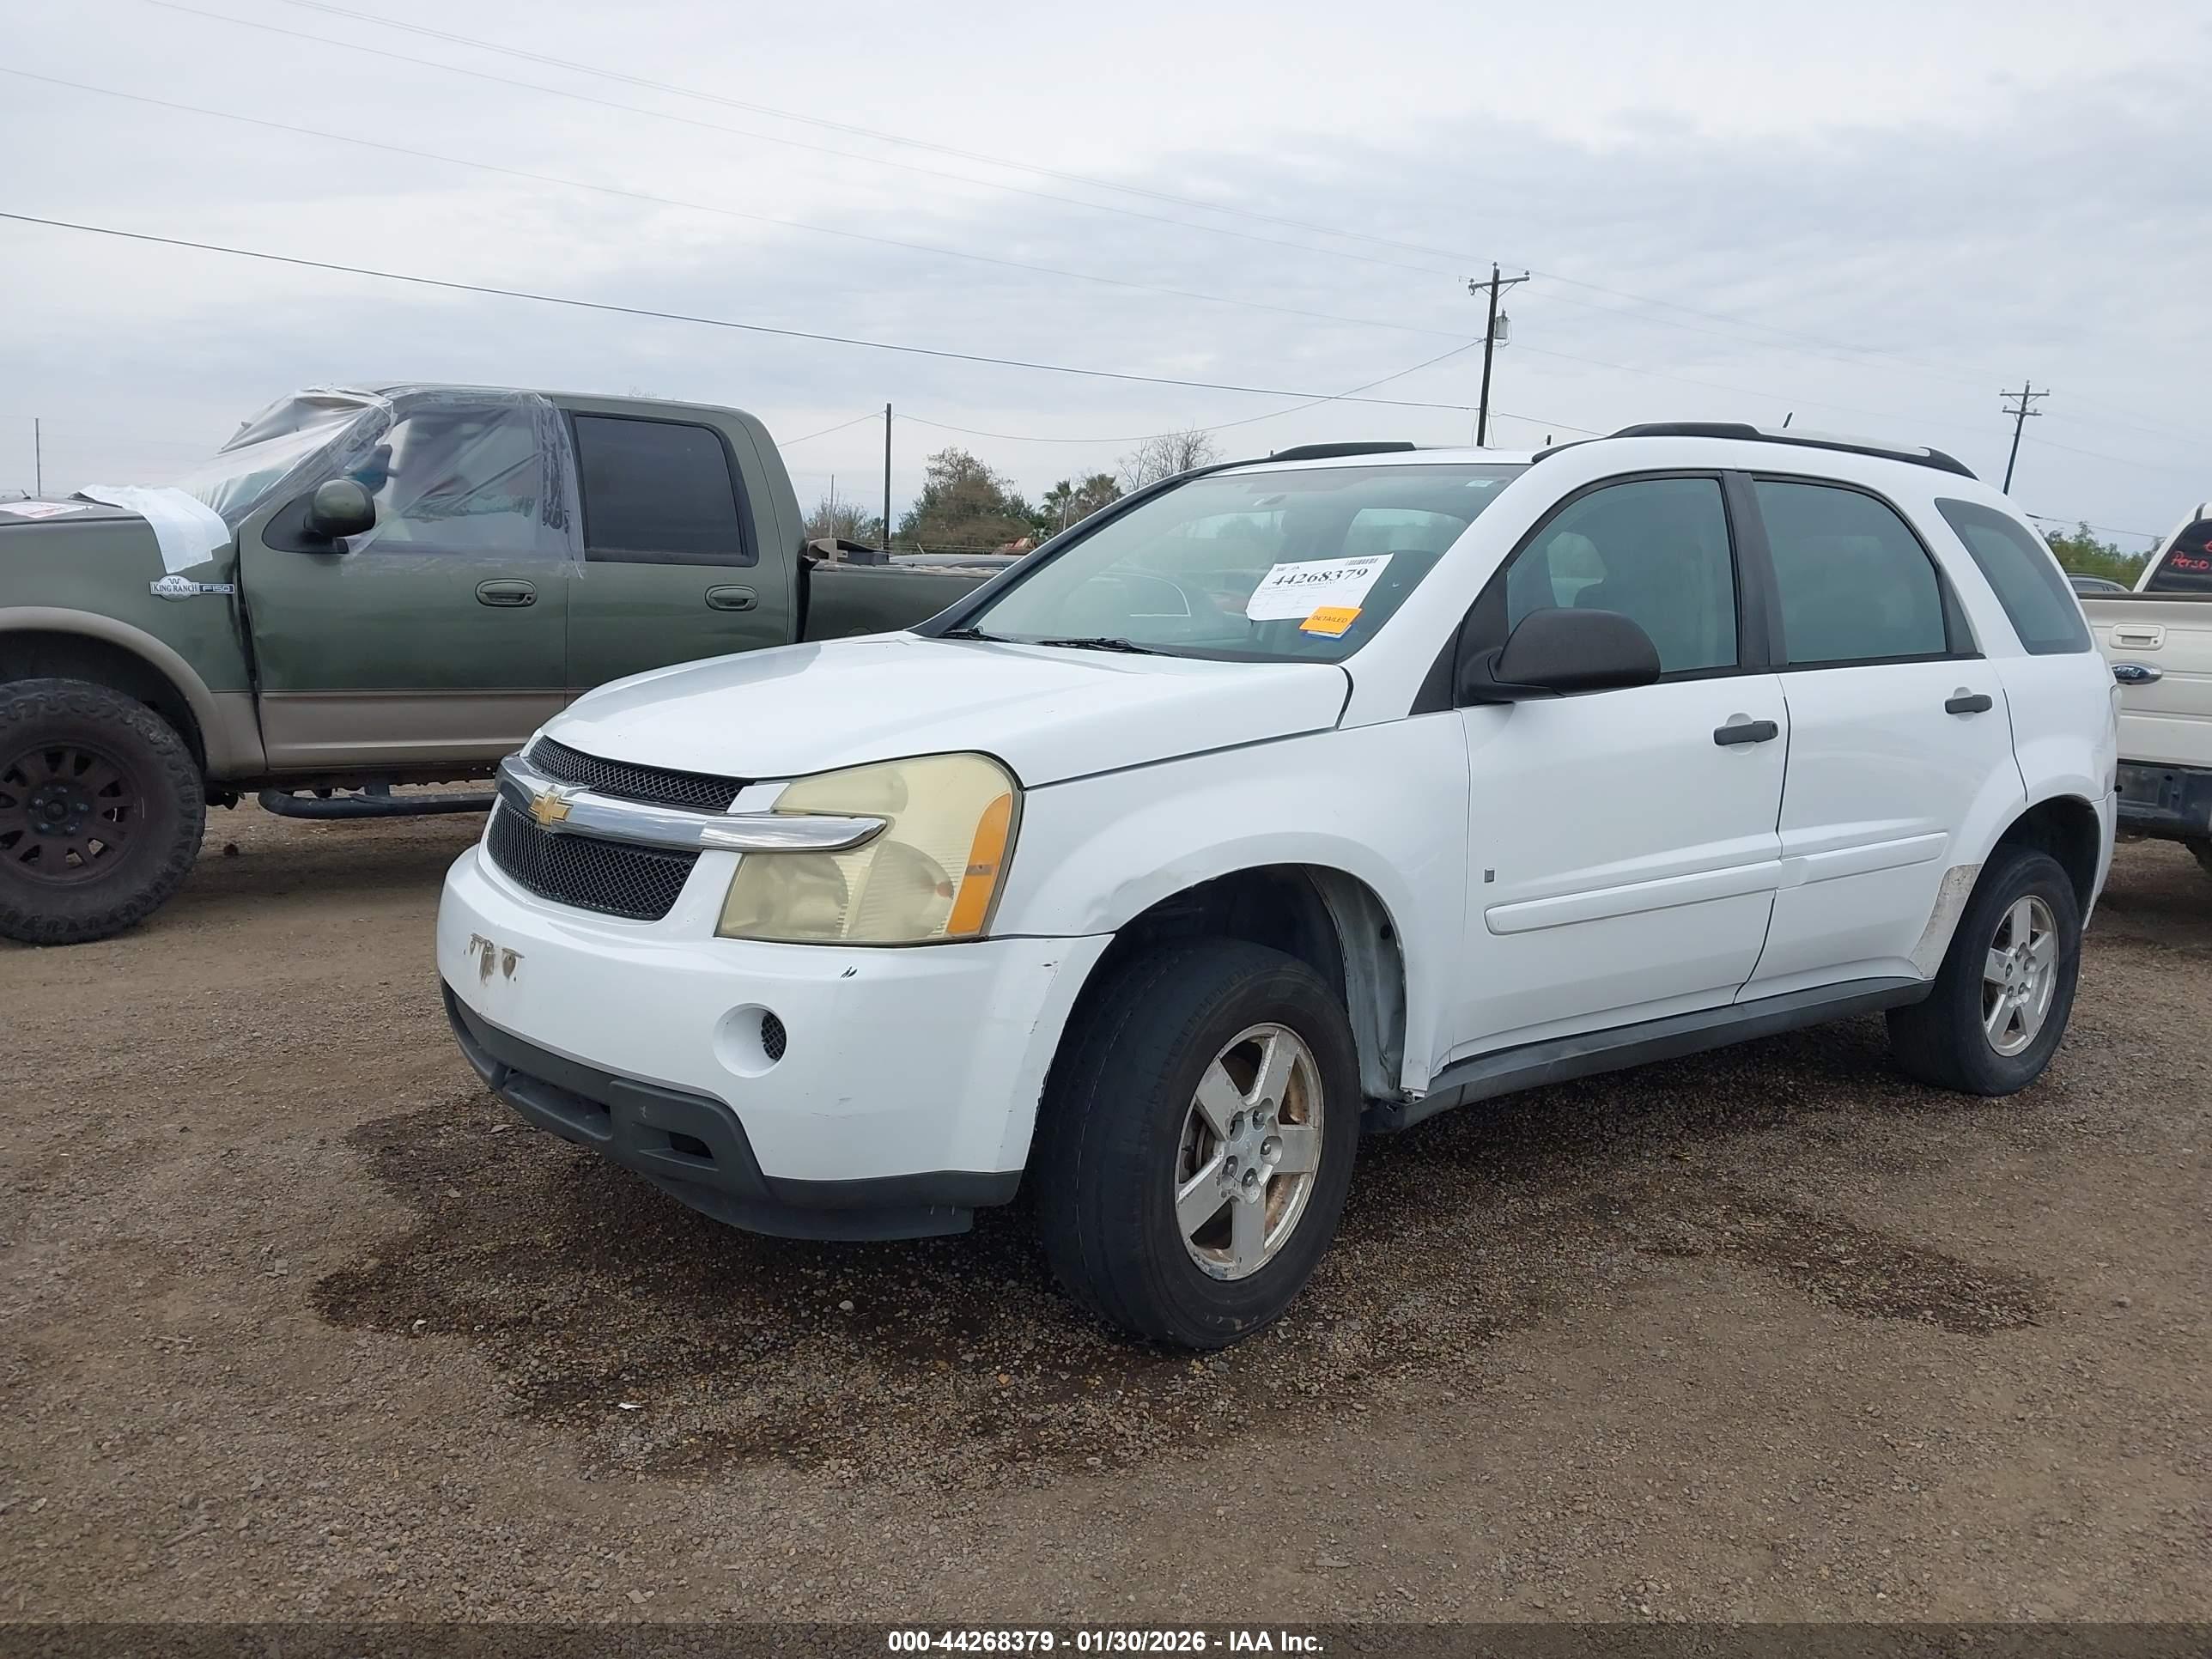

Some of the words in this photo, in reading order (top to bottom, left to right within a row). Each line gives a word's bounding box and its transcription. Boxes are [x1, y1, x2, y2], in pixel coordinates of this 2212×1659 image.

[1273, 568, 1369, 586] 44268379
[153, 583, 172, 592] KING
[173, 584, 198, 592] RANCH
[1312, 615, 1348, 623] DETAILED
